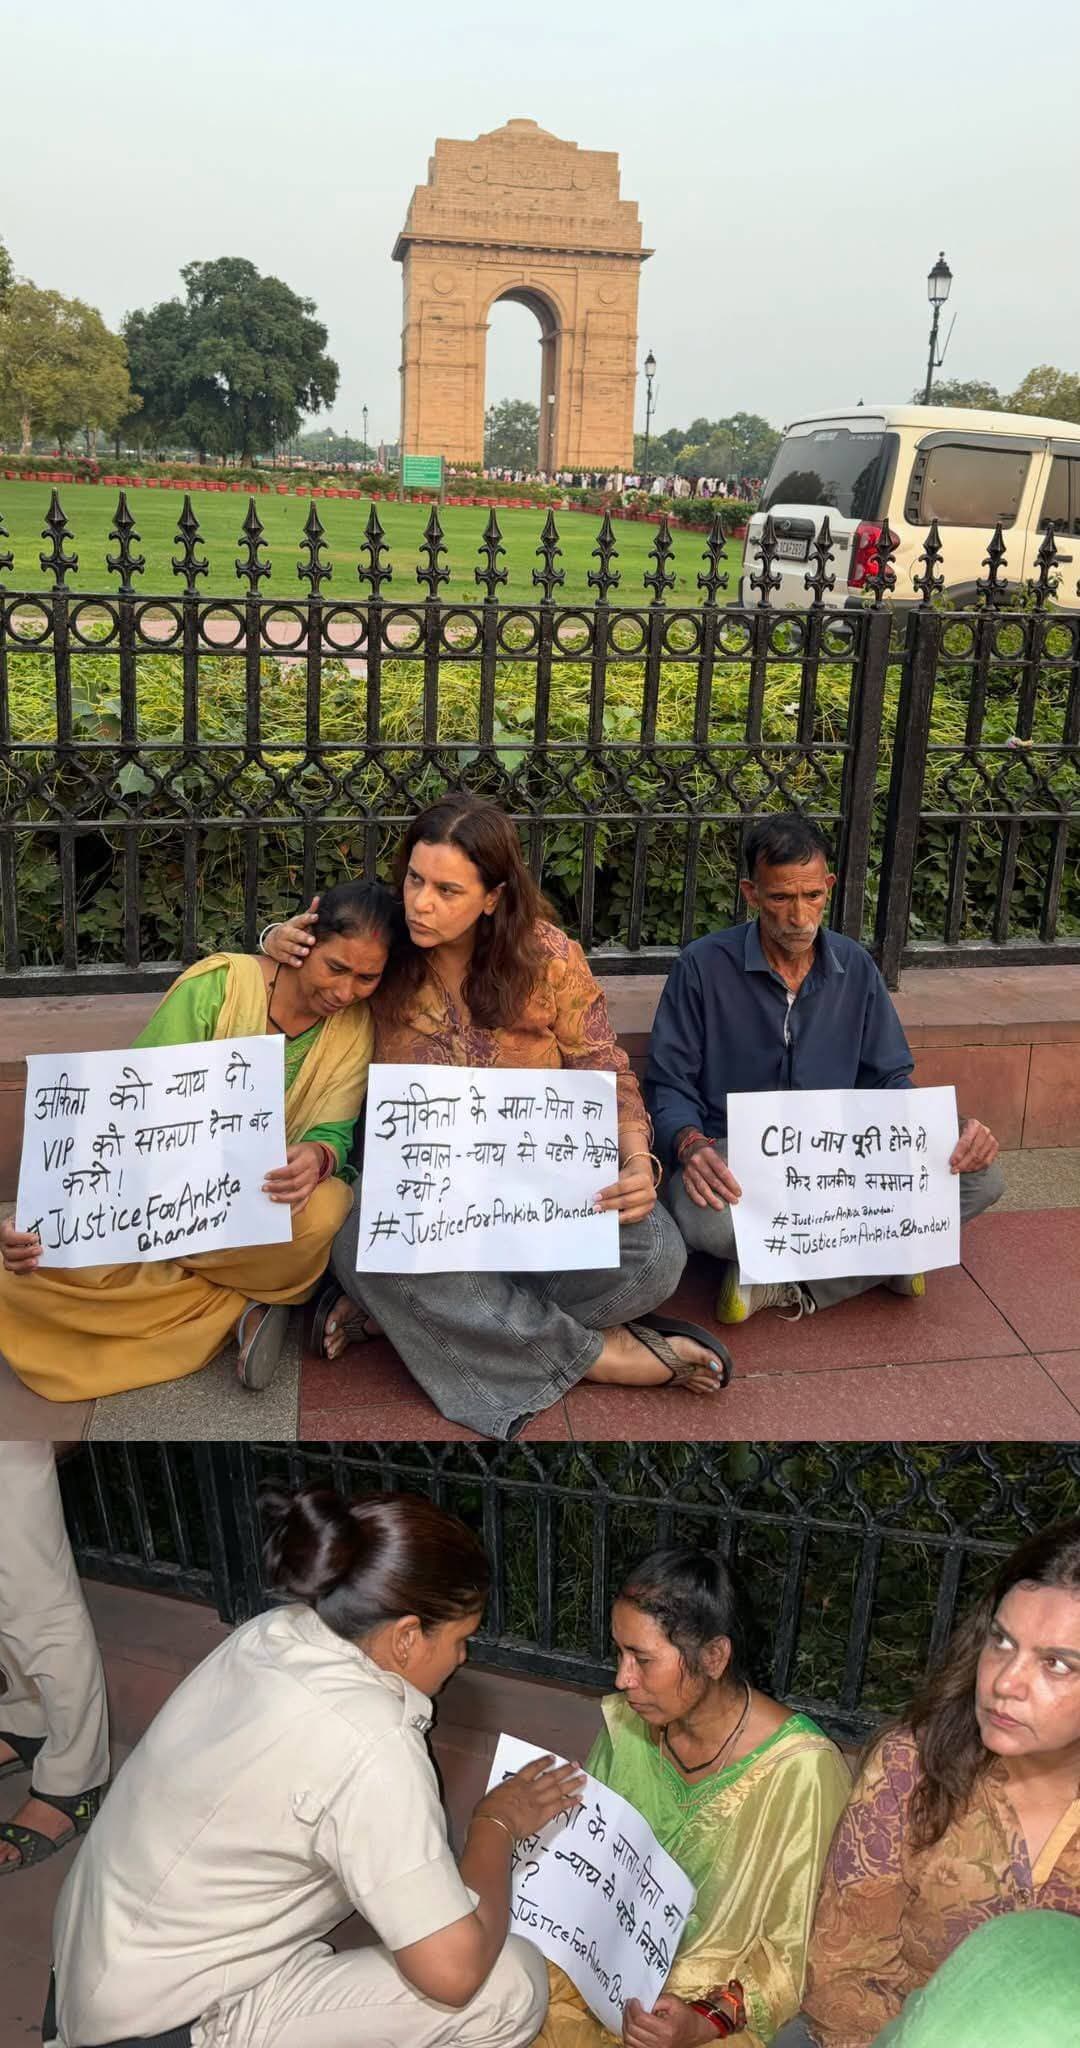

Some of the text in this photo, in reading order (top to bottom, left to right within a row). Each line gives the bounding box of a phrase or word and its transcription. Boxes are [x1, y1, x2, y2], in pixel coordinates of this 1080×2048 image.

[109, 1066, 153, 1111] को
[165, 1069, 209, 1098] न्याय
[374, 1082, 462, 1140] अंकिता
[469, 1085, 487, 1125] के
[582, 1099, 604, 1121] का
[43, 1136, 75, 1172] VIP
[92, 1123, 126, 1160] को
[209, 1109, 243, 1140] देना
[516, 1131, 538, 1163] से
[545, 1134, 579, 1163] पहले
[761, 1125, 801, 1157] CBI
[852, 1125, 882, 1159] पूरी
[889, 1125, 912, 1152] होने
[786, 1165, 930, 1193] फिर राजकीय सम्मान दो
[588, 1803, 606, 1842] के
[664, 1903, 685, 1934] का
[602, 1873, 616, 1902] से
